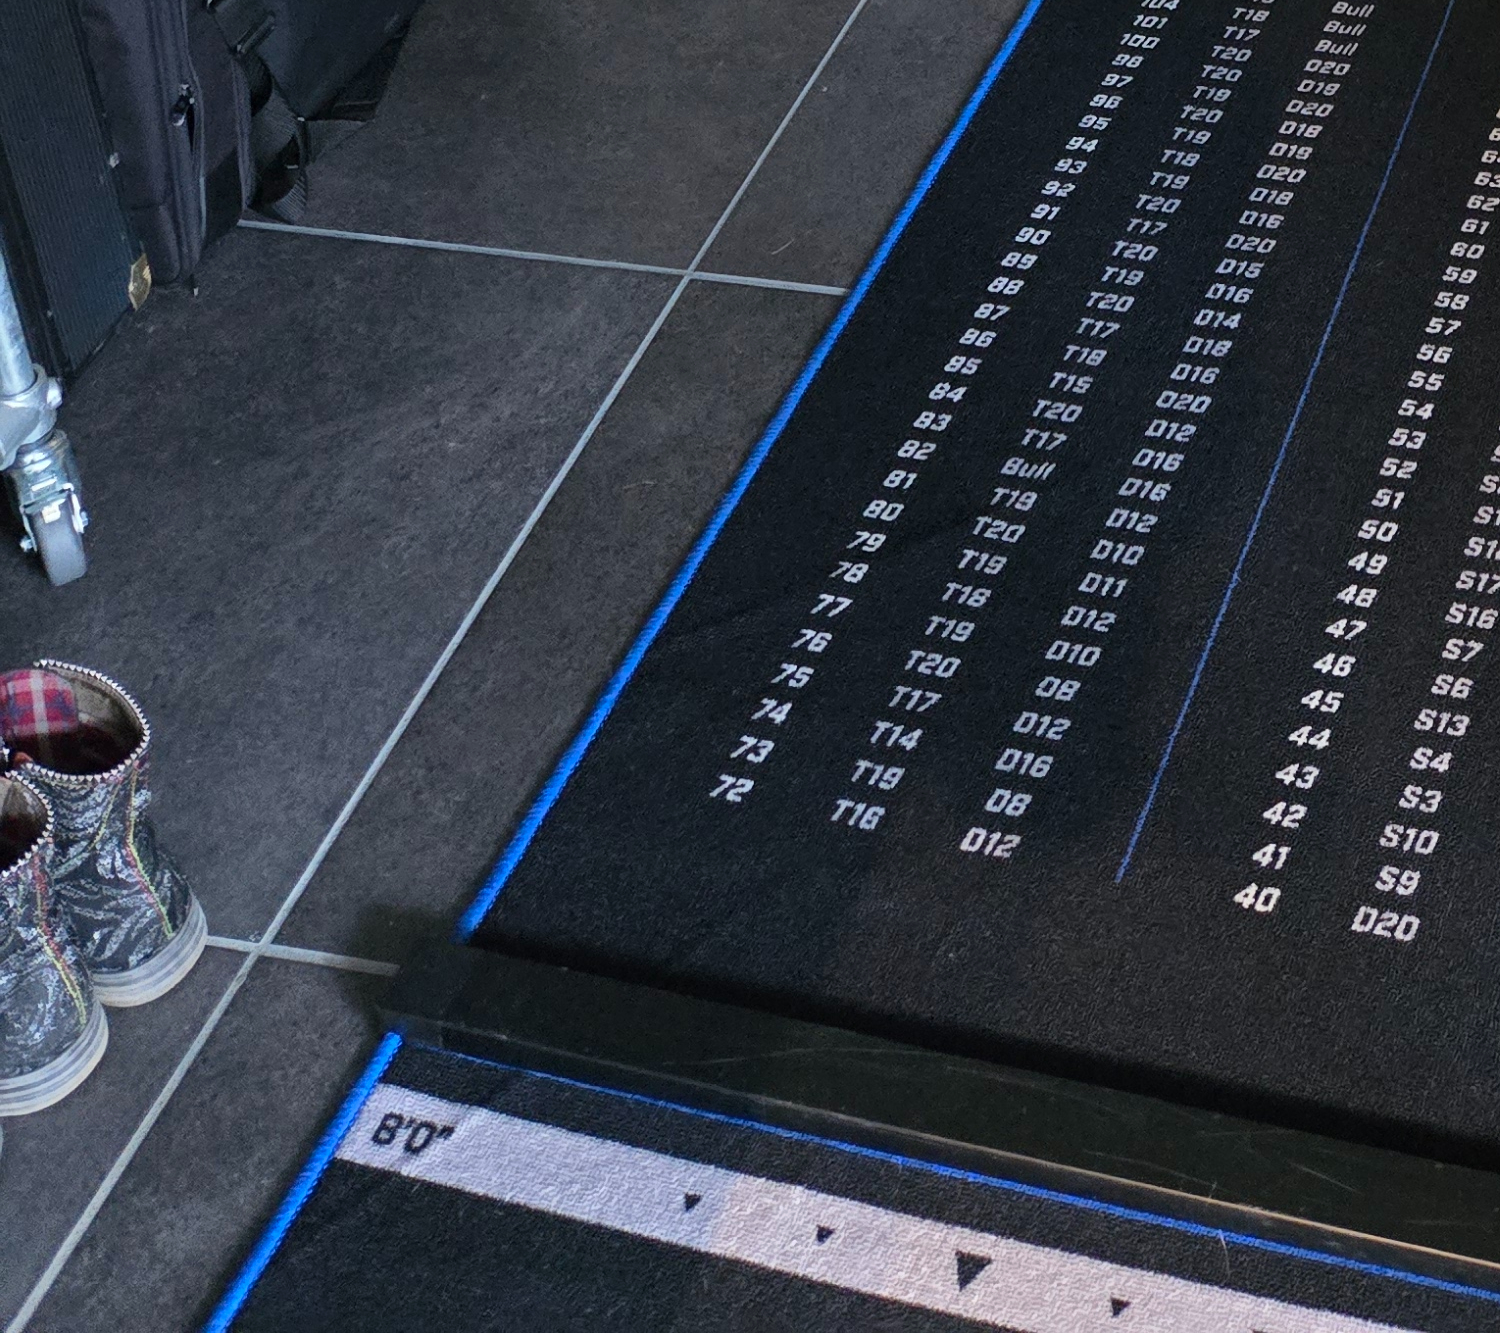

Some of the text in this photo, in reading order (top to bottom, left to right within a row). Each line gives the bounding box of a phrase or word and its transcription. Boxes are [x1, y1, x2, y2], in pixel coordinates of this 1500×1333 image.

[1133, 14, 1359, 56] 101 T17 Bull
[1101, 73, 1334, 117] 97 T19 D20
[1054, 158, 1294, 206] 93 T19 D18
[1450, 242, 1485, 259] 60
[1000, 251, 1254, 303] 89 T19 D16
[1425, 317, 1462, 336] 57
[944, 355, 1212, 413] 85 T15 D20
[1398, 399, 1434, 420] 54
[897, 439, 1171, 501] 82 Bull D16
[1371, 488, 1405, 509] 51
[830, 561, 1116, 632] 78 T18 D12
[1337, 584, 1378, 608] 48
[1445, 602, 1498, 629] S16
[772, 663, 1071, 740] 75 T17 D12
[1301, 689, 1344, 713] 45
[1414, 709, 1470, 737] S13
[710, 774, 1021, 858] 72 T16 D12
[1263, 801, 1307, 828] 42
[1379, 824, 1439, 855] S10
[1234, 883, 1420, 941] 40 D20
